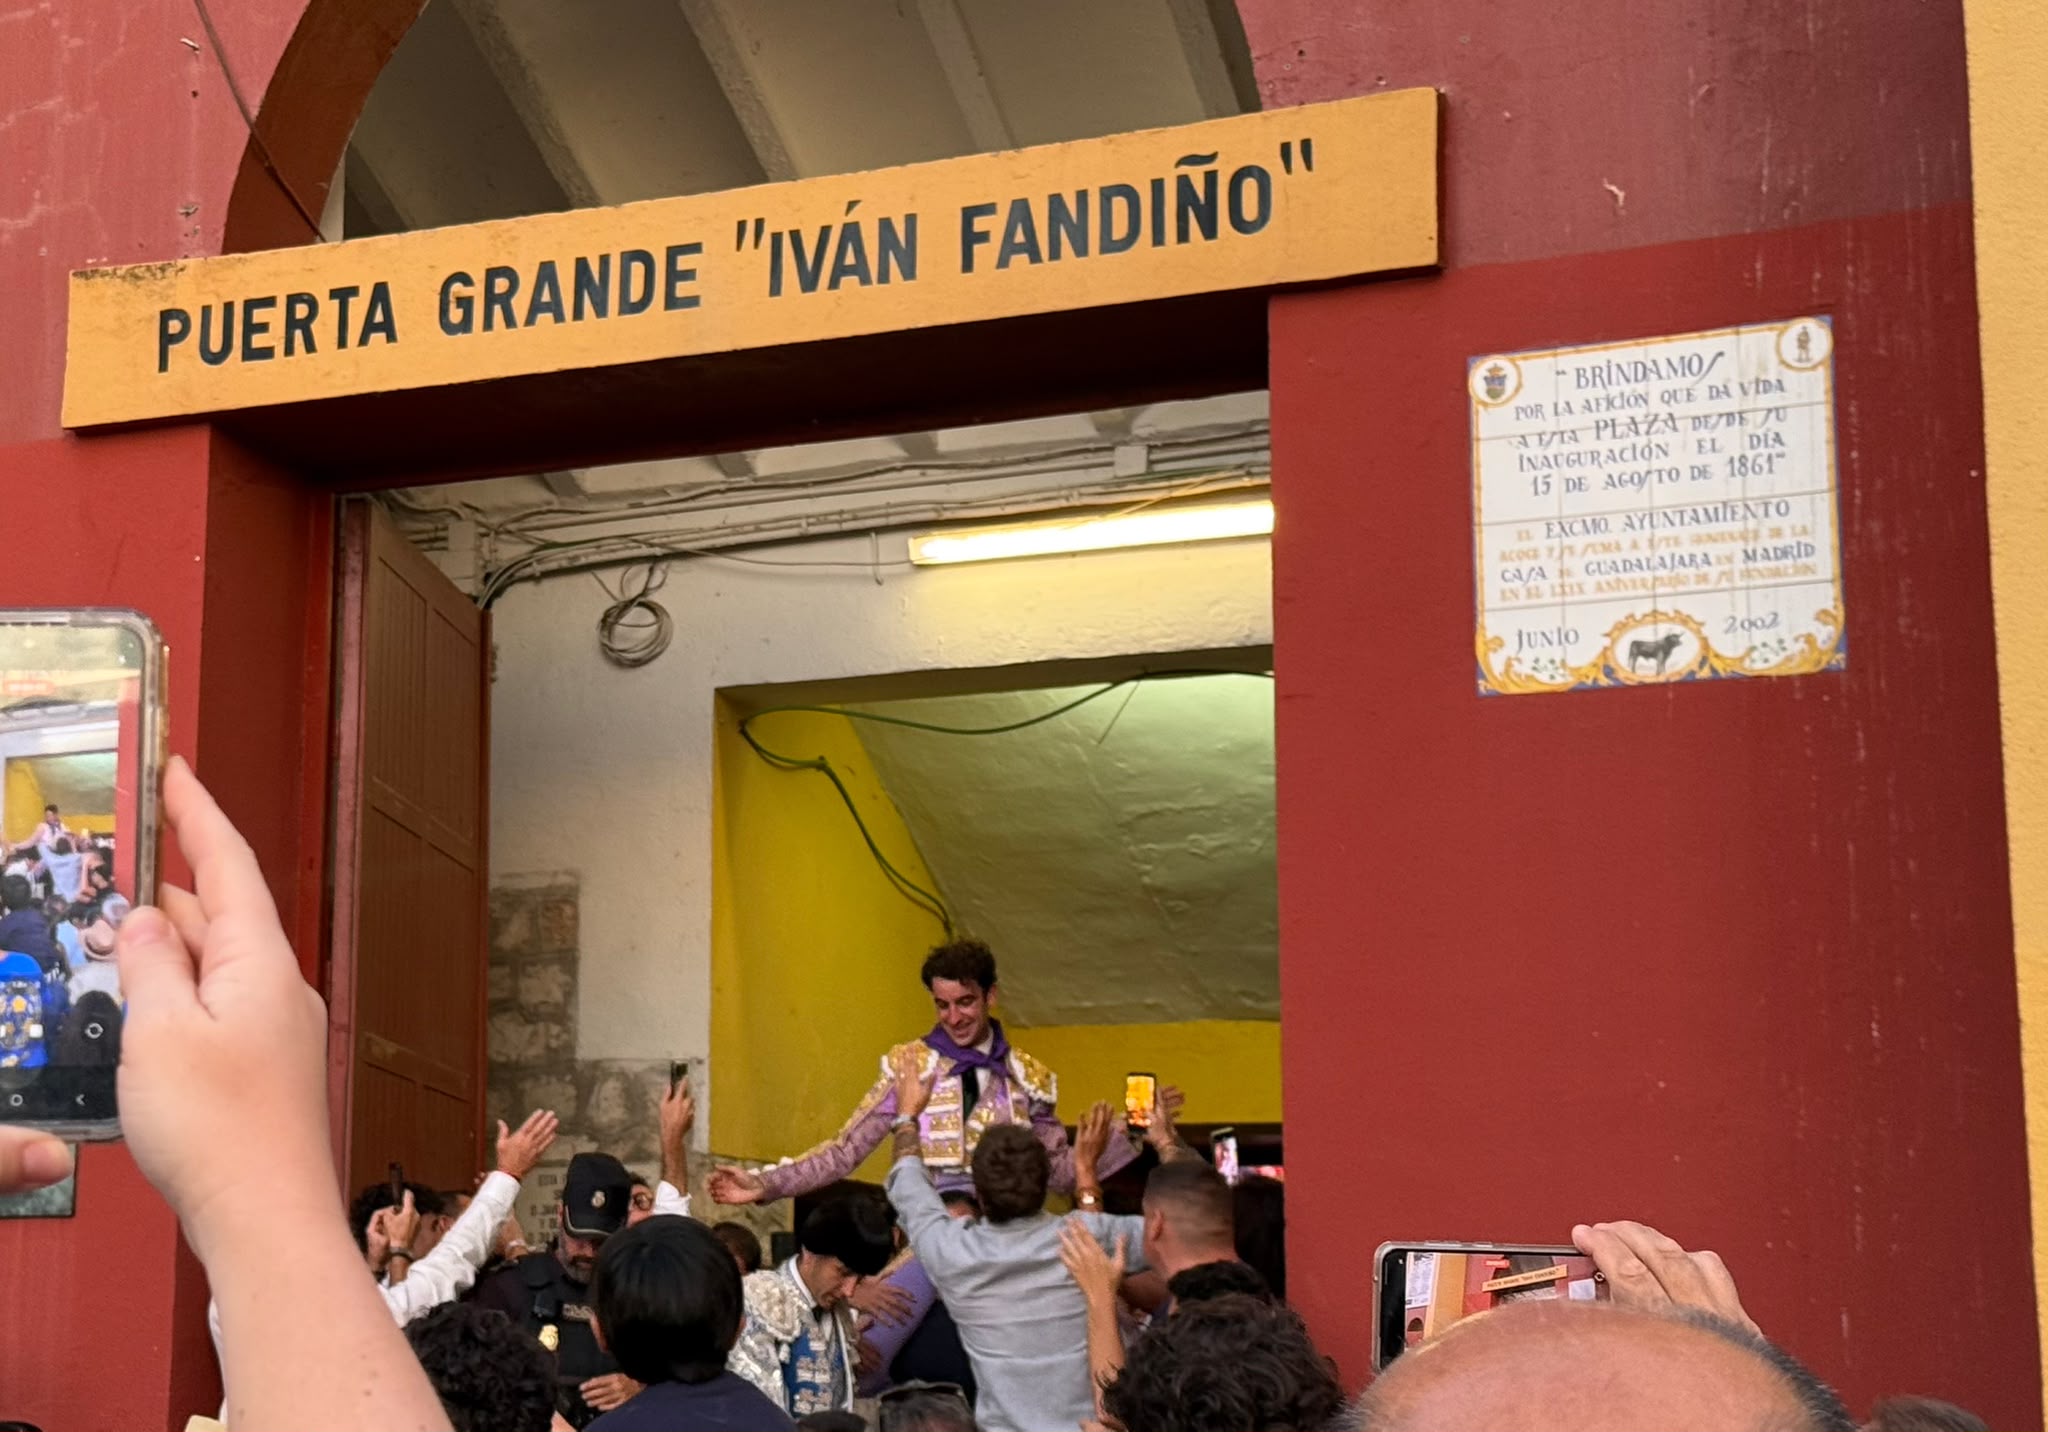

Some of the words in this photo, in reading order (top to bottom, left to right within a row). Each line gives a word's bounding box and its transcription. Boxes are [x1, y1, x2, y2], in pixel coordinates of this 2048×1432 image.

[158, 281, 398, 373] PUERTA
[438, 242, 703, 335] GRANDE
[735, 200, 918, 298] "IVÁN
[960, 137, 1314, 274] FANDIÑO"
[1515, 404, 1545, 421] POR
[1553, 400, 1573, 417] LA
[1661, 385, 1696, 405] QUE
[1740, 377, 1786, 398] VIDA
[1594, 412, 1679, 441] PLAZA
[1696, 438, 1722, 455] EL
[1532, 474, 1552, 497] 15
[1565, 477, 1590, 494] DE
[1690, 464, 1713, 482] DE
[1516, 529, 1533, 542] EL
[1623, 498, 1790, 532] AYUNTAMIENTO
[1584, 552, 1712, 577] GUADALAJARA
[1742, 540, 1816, 564] MADRID
[1515, 627, 1580, 653] JUNIO
[1722, 612, 1782, 635] 2002
